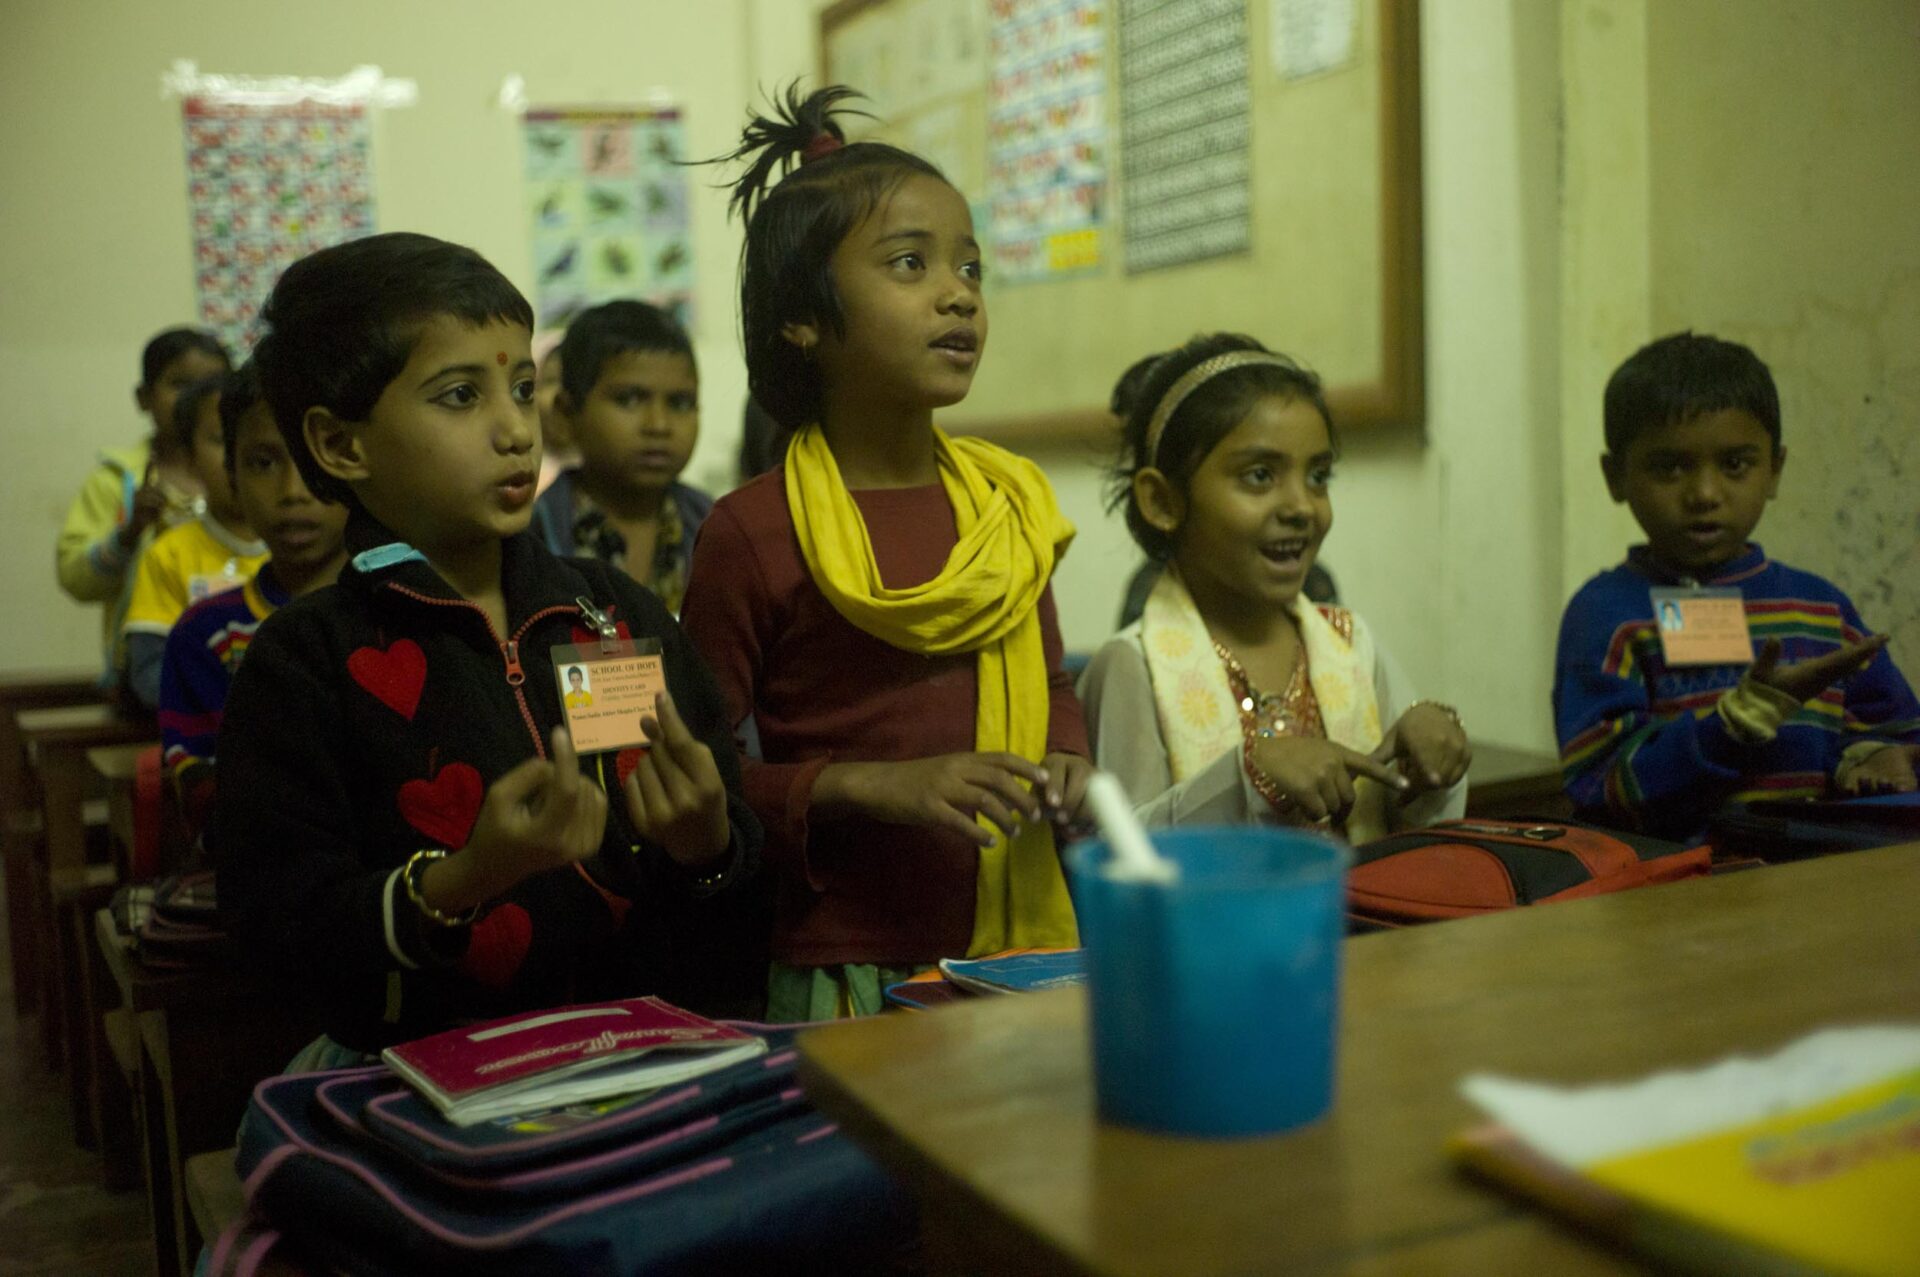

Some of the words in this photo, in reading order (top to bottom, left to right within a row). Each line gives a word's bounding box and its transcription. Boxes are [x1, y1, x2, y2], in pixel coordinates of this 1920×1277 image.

[591, 664, 623, 675] SCHOOL
[625, 663, 635, 671] OF
[637, 661, 657, 670] HOPE
